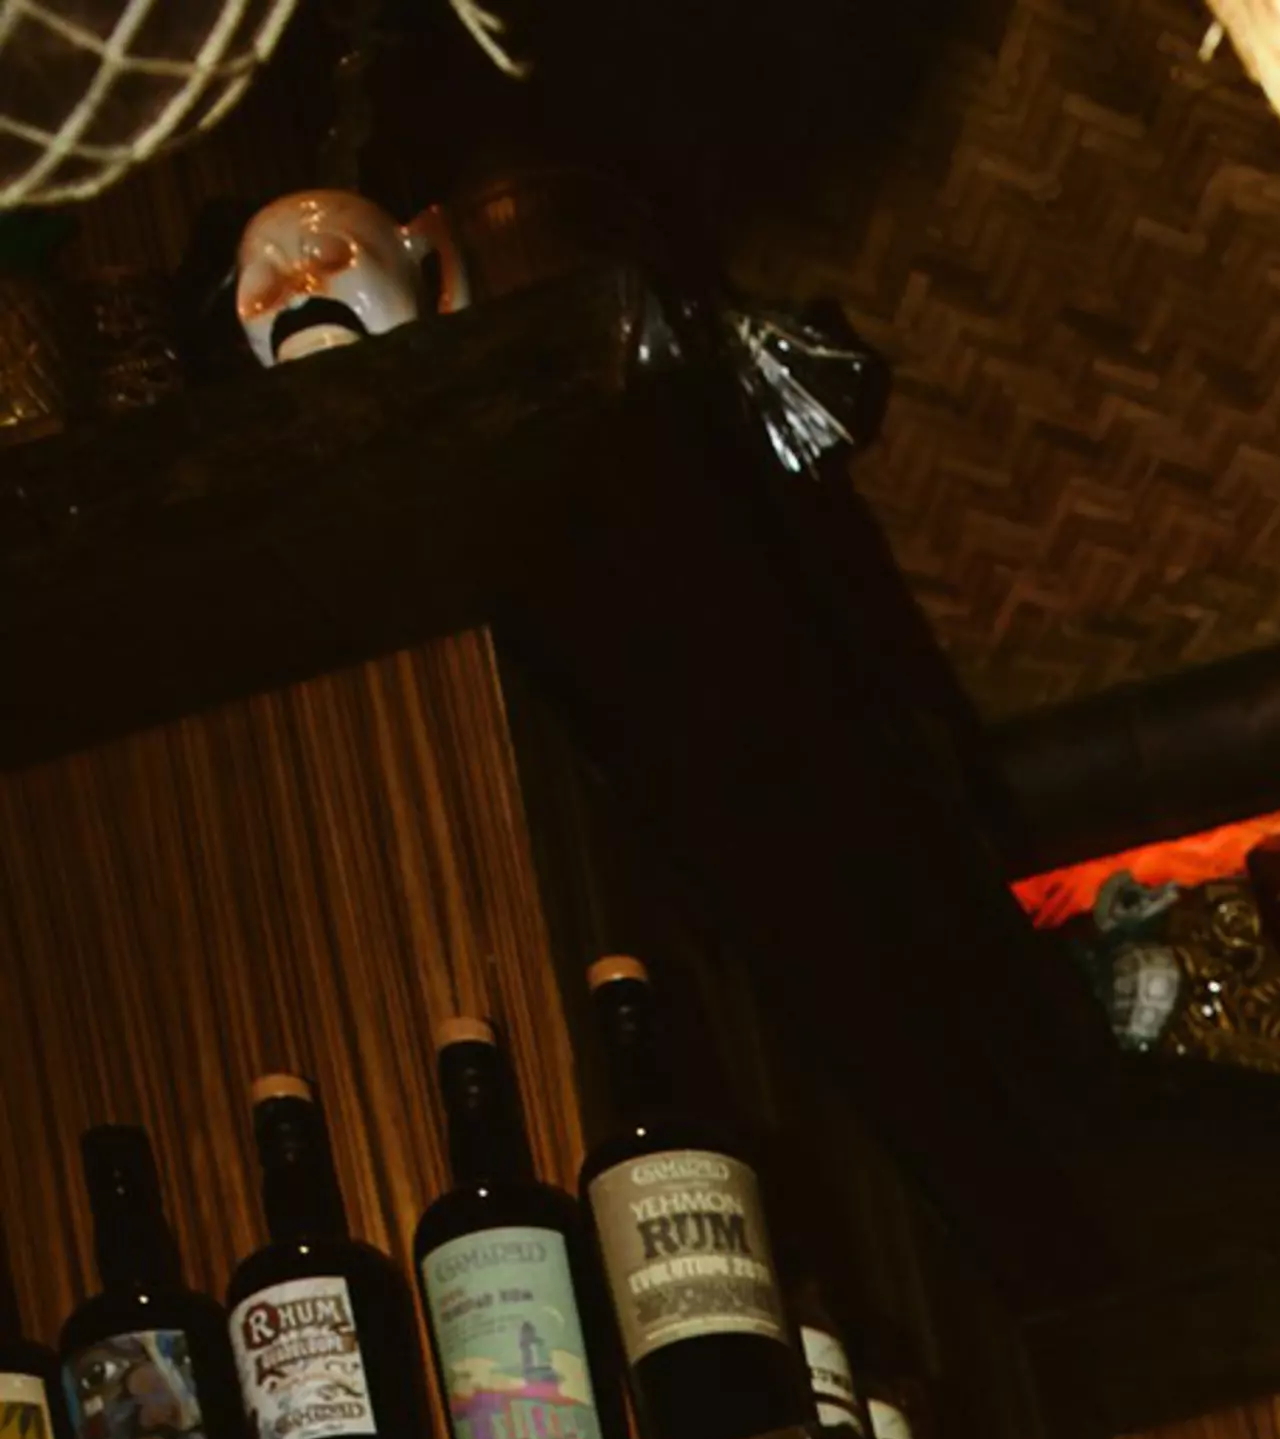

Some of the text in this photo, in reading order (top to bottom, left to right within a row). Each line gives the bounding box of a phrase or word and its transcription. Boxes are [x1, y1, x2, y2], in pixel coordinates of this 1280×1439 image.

[629, 1190, 744, 1222] YEHMON
[637, 1213, 753, 1259] RUM
[247, 1296, 345, 1346] RHUM
